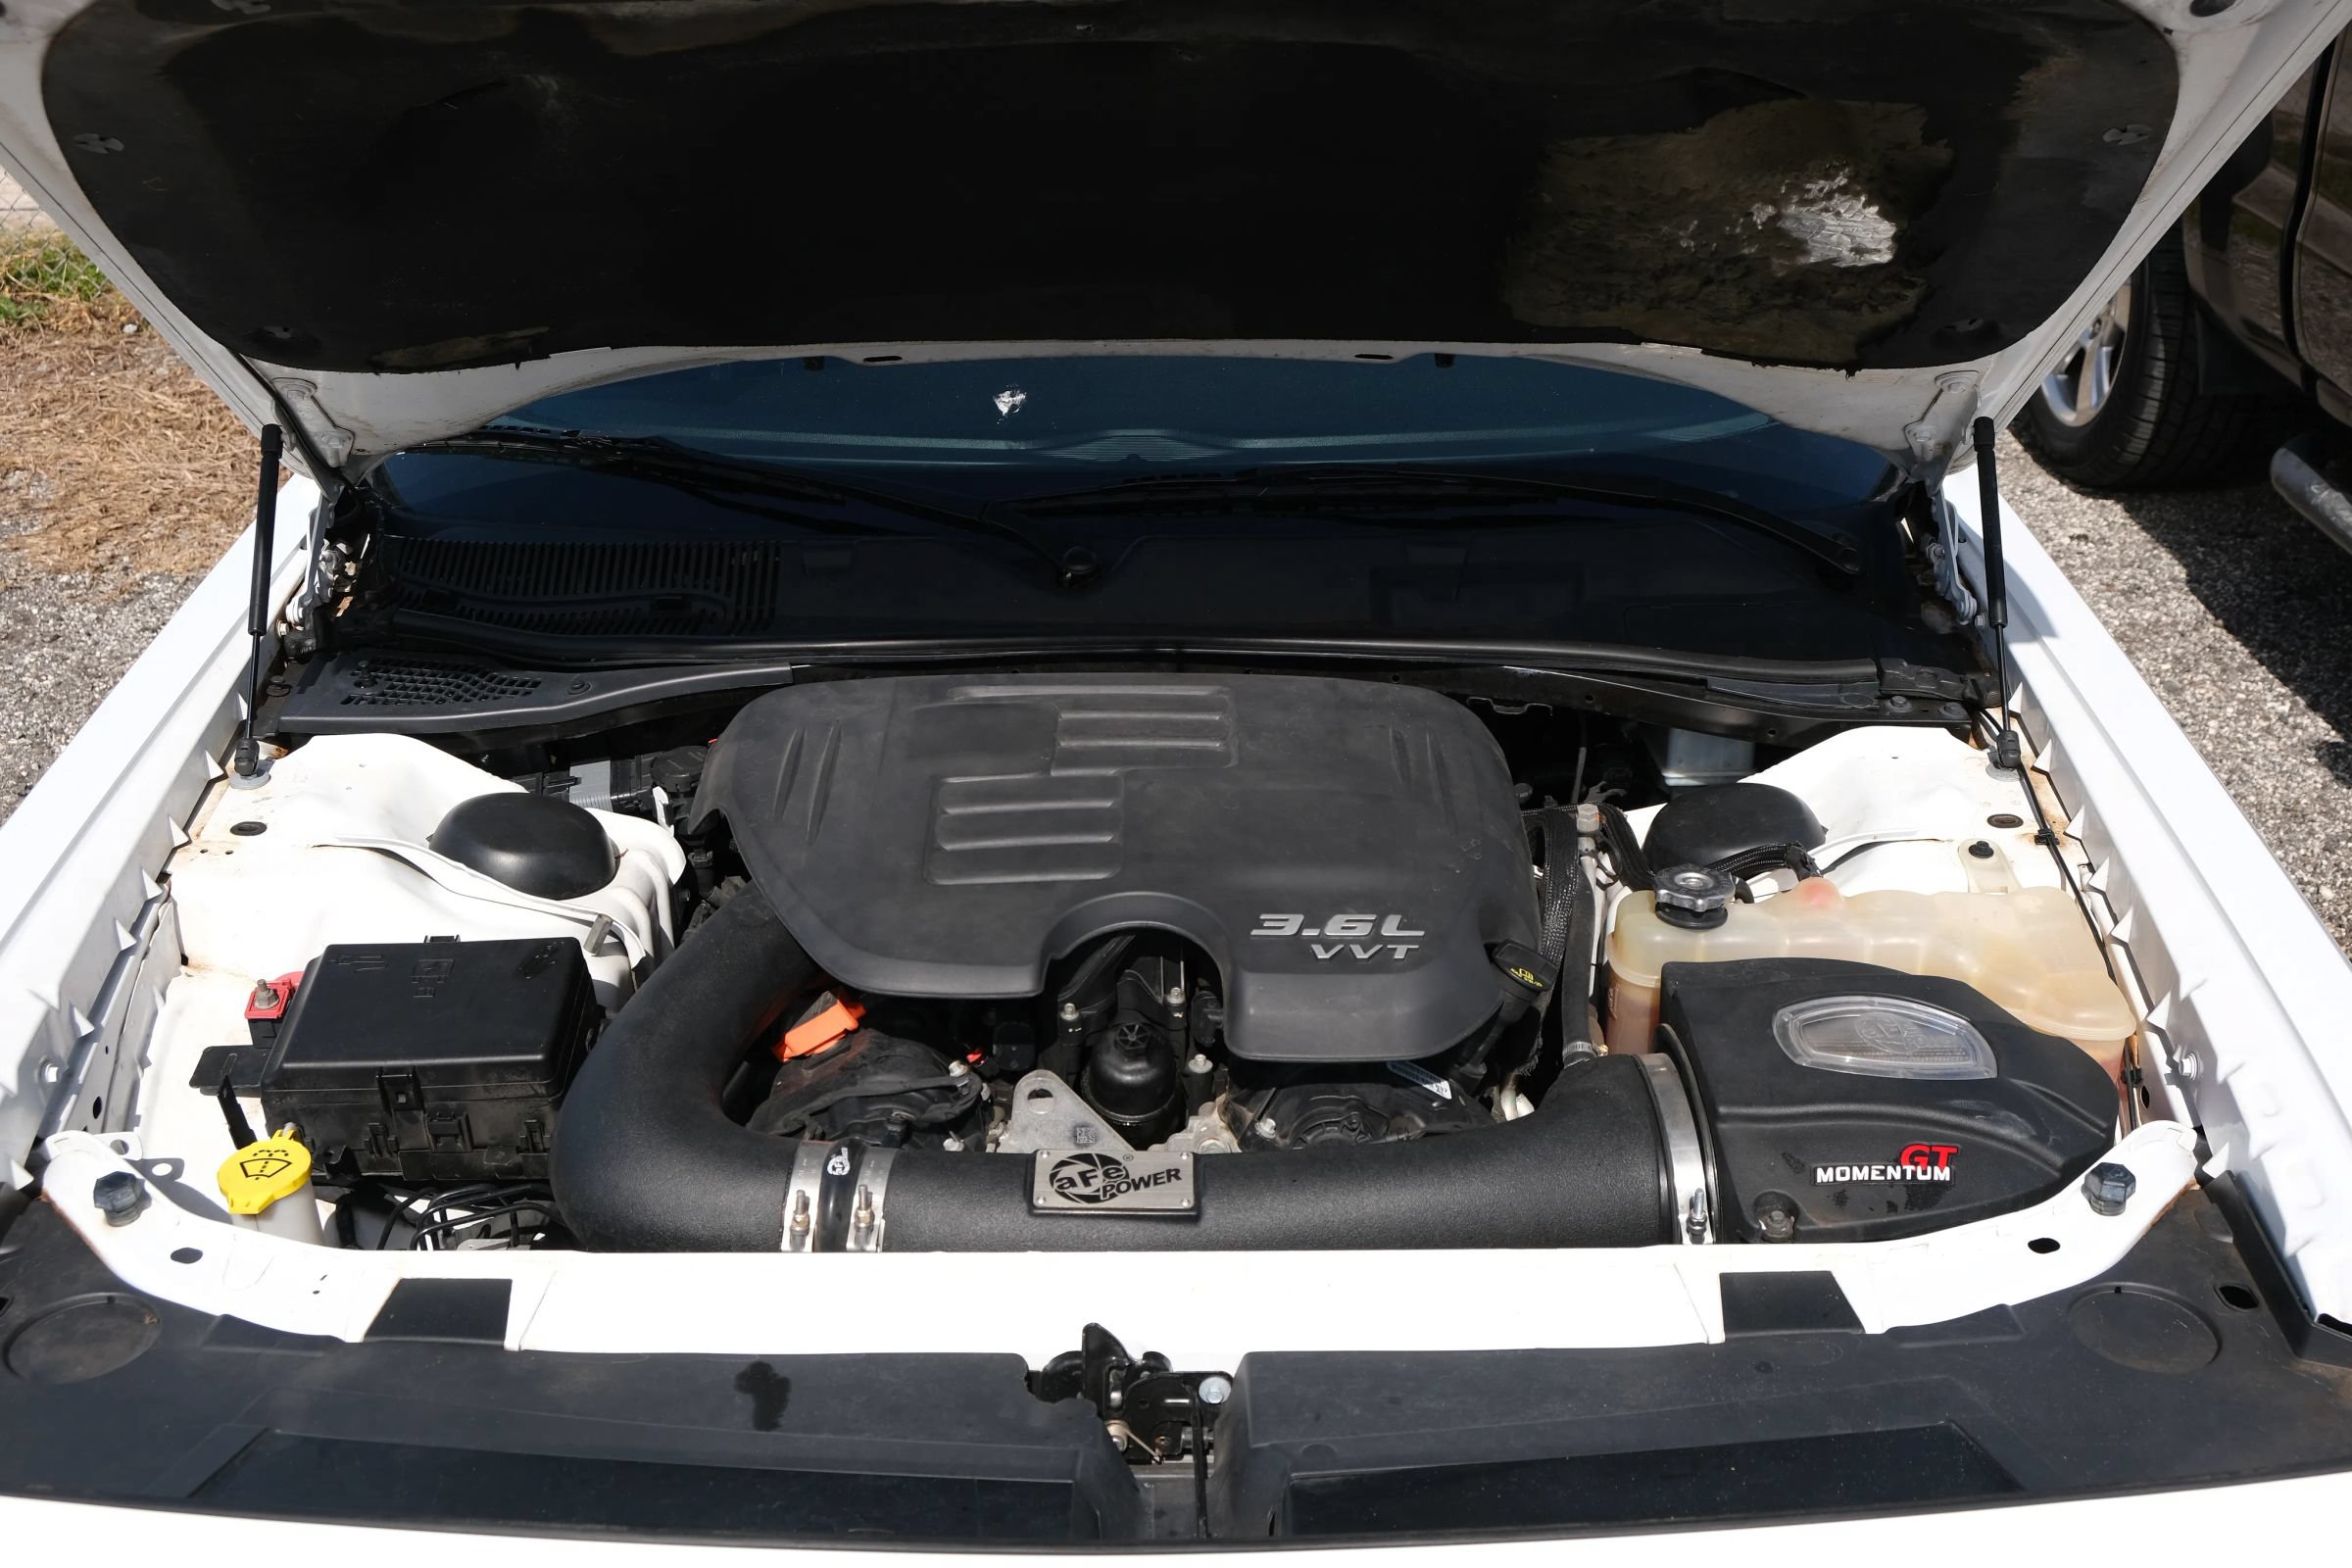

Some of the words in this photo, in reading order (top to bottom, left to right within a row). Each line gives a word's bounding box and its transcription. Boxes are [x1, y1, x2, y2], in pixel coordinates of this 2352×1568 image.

[1250, 914, 1425, 936] 3.6L
[1311, 944, 1419, 959] VVT
[1900, 1144, 1958, 1171] GT
[1054, 1166, 1125, 1191] aFe
[1100, 1168, 1182, 1200] POWER
[1816, 1164, 1950, 1183] MOMENTUM
